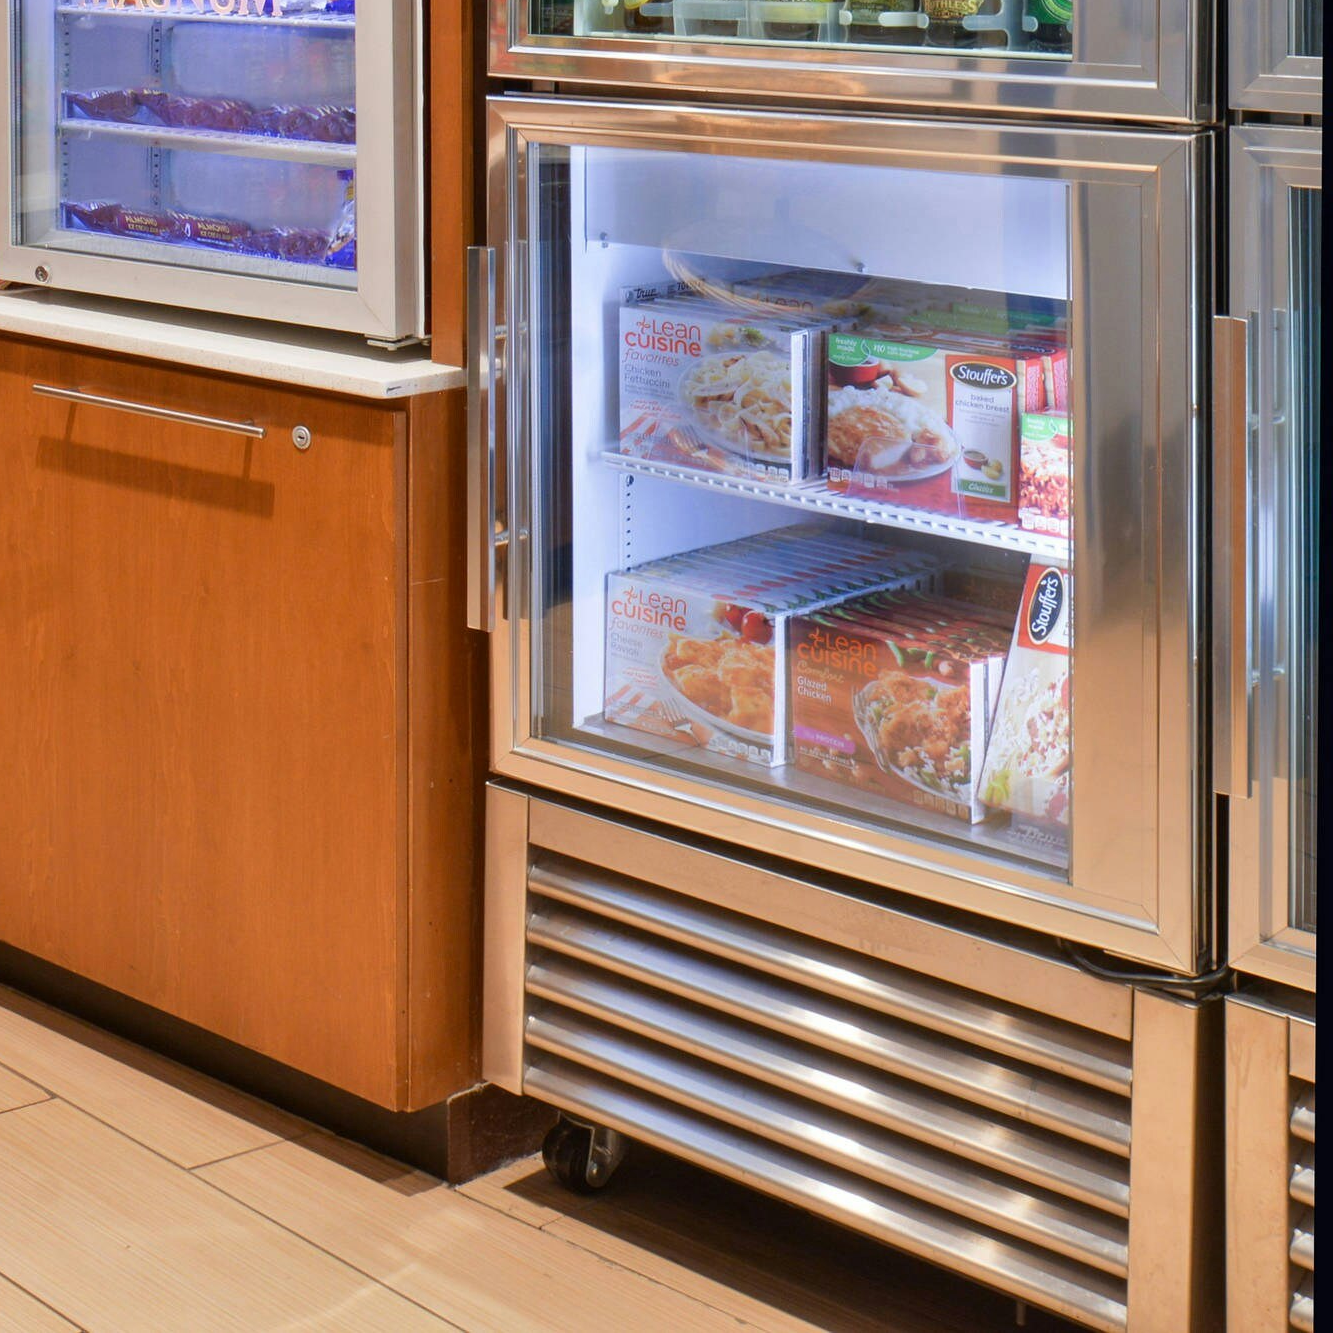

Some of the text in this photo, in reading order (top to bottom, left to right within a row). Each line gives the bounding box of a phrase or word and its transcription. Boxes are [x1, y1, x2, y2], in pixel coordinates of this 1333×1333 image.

[652, 320, 701, 341] Lean
[622, 348, 679, 367] favorites
[624, 364, 662, 377] Chicken
[958, 366, 1008, 385] Stouffer's
[955, 401, 1010, 413] chicken breast
[970, 394, 995, 403] baked
[639, 590, 688, 616] Lean
[1032, 571, 1062, 636] Stouffer's
[826, 633, 877, 659] Lean
[797, 676, 827, 690] Glazed
[797, 686, 832, 703] Chicken
